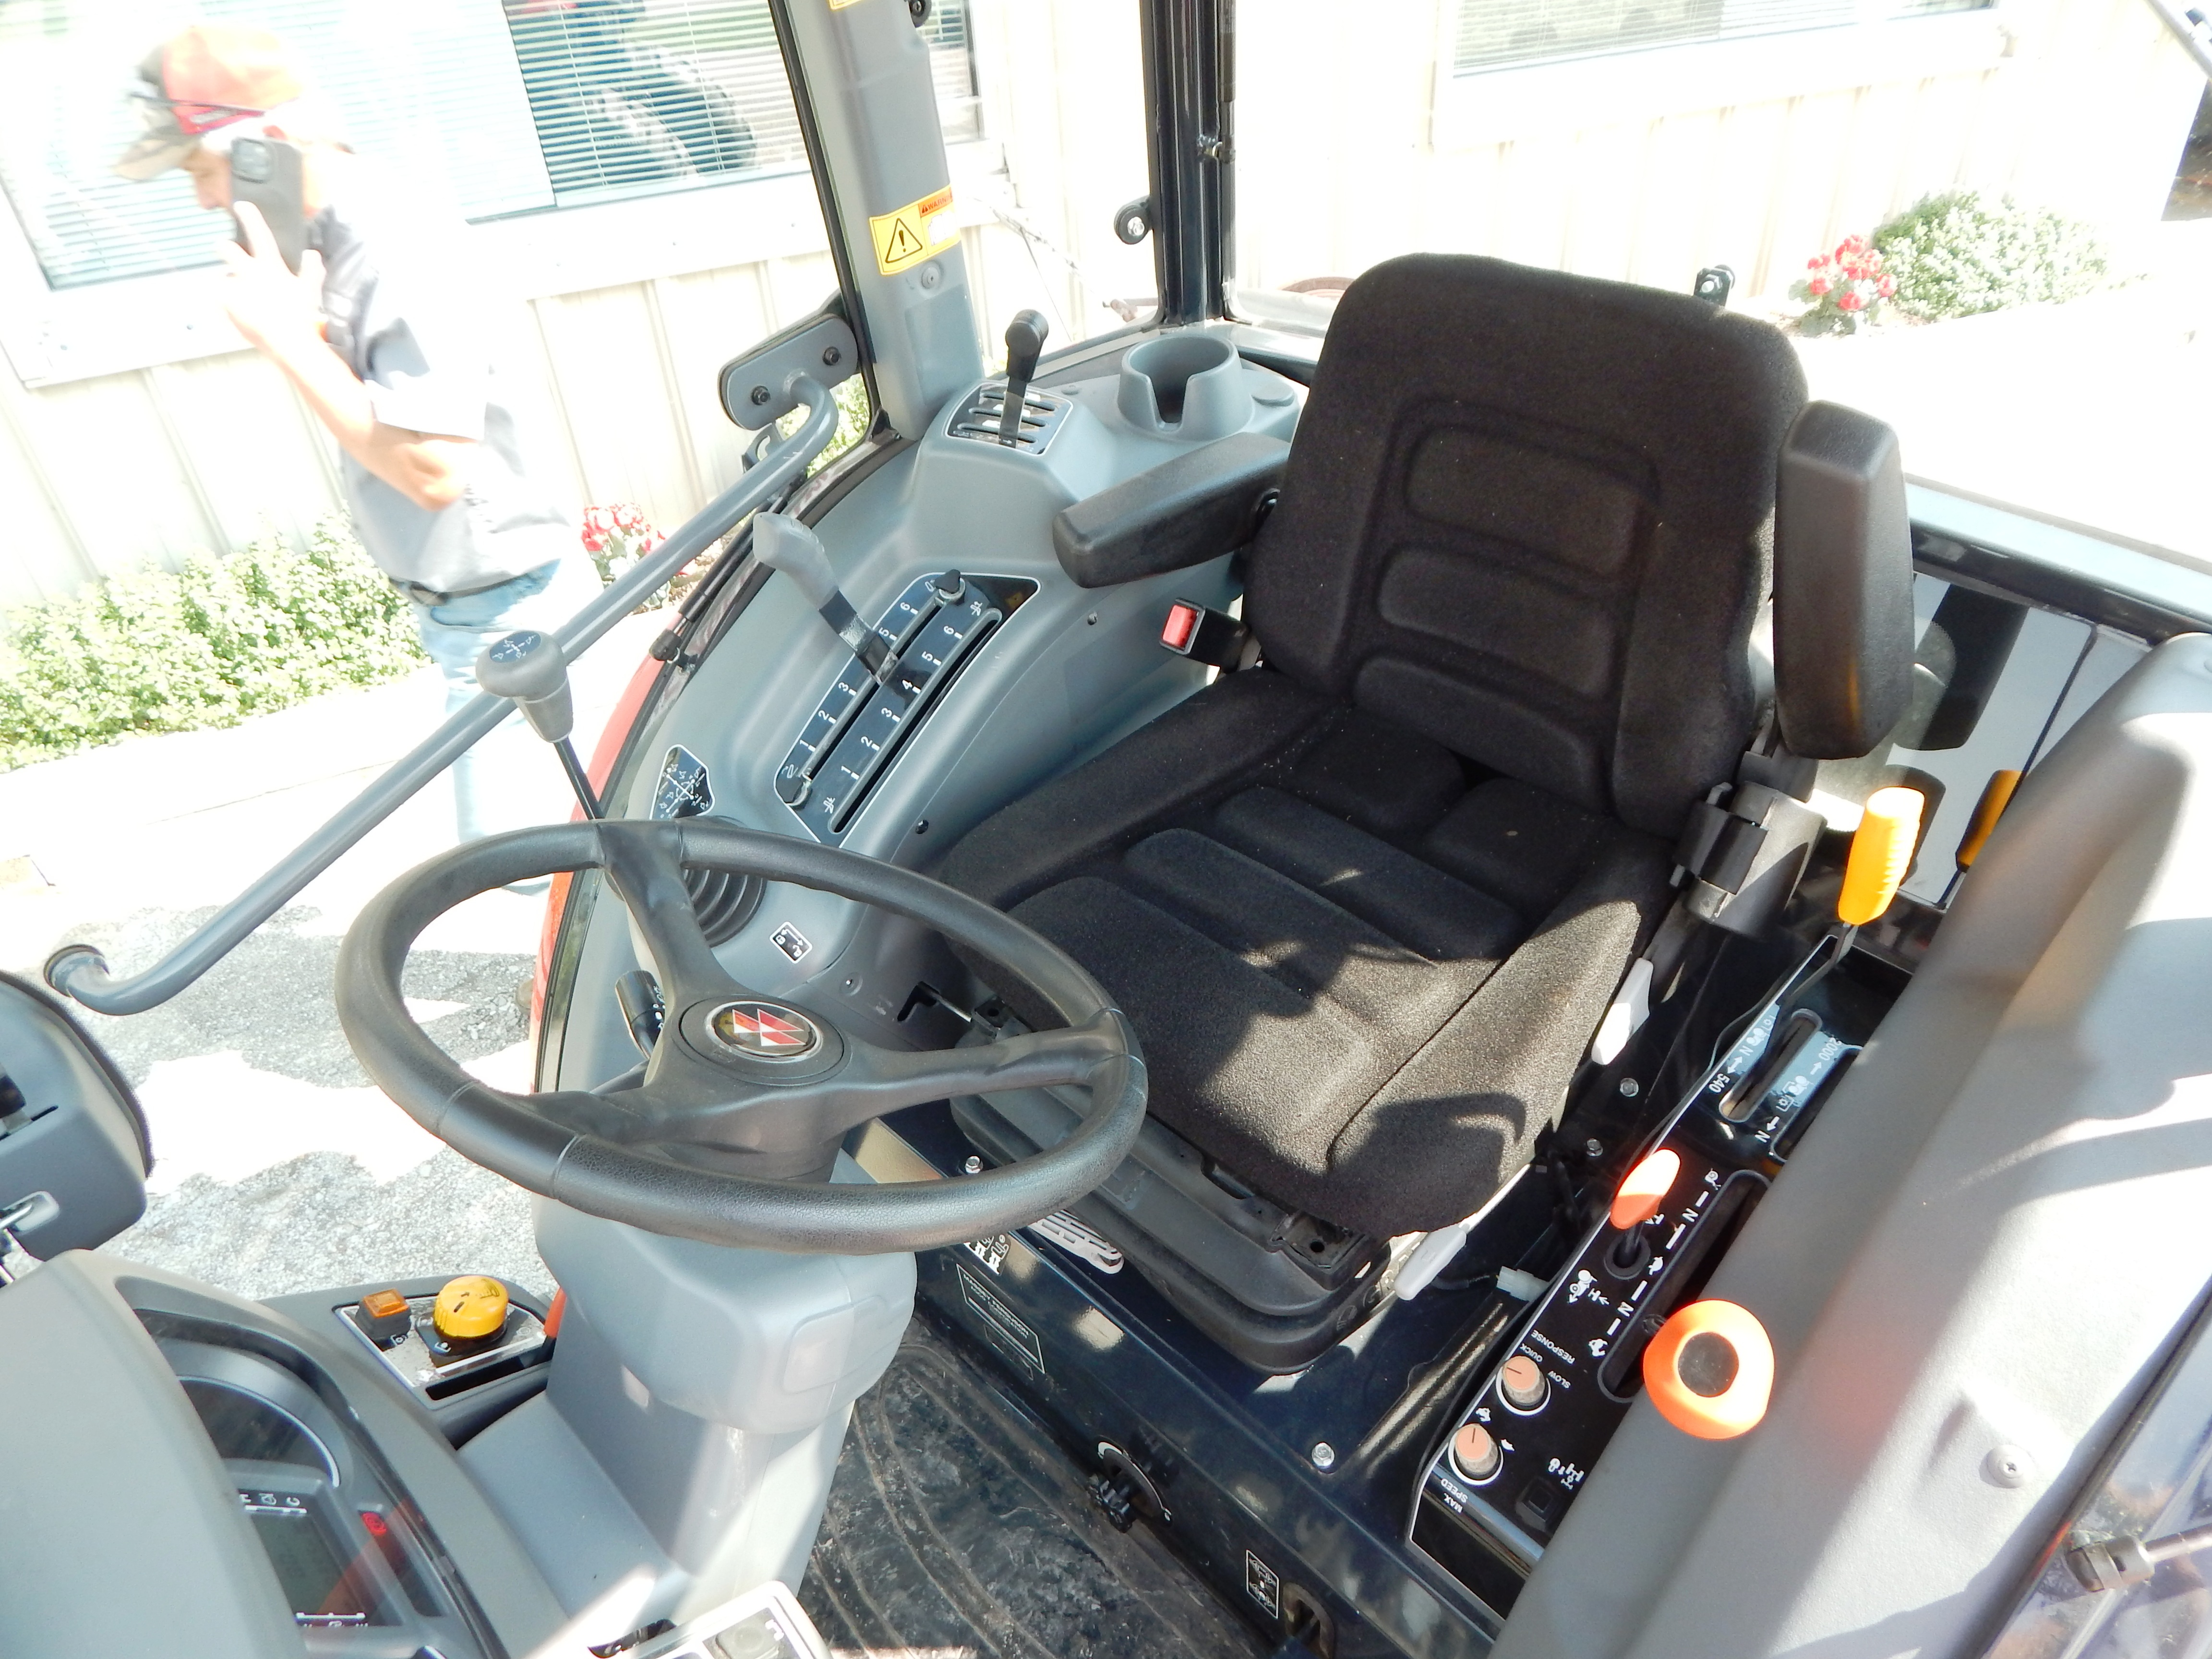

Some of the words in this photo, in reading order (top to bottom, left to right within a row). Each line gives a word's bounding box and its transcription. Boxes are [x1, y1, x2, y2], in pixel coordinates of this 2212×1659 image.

[900, 601, 911, 612] 6
[878, 626, 890, 637] 5
[943, 625, 955, 635] 6
[921, 650, 934, 662] 5
[838, 682, 849, 692] 3
[902, 679, 913, 690] 4
[817, 709, 830, 721] 2
[880, 707, 893, 718] 3
[799, 739, 809, 747] 1
[860, 735, 873, 748] 2
[840, 765, 852, 774] 1
[1738, 1045, 1755, 1057] N
[1818, 1037, 1842, 1061] 2000
[1708, 1073, 1731, 1093] 540
[1754, 1130, 1771, 1143] N
[1682, 1208, 1699, 1223] N
[1617, 1301, 1635, 1317] N
[1519, 1343, 1543, 1362] QUICK
[1530, 1329, 1575, 1364] RESPONSE
[1548, 1370, 1571, 1389] SLOW
[1441, 1478, 1468, 1503] SPEED
[1443, 1492, 1463, 1513] MAX.
